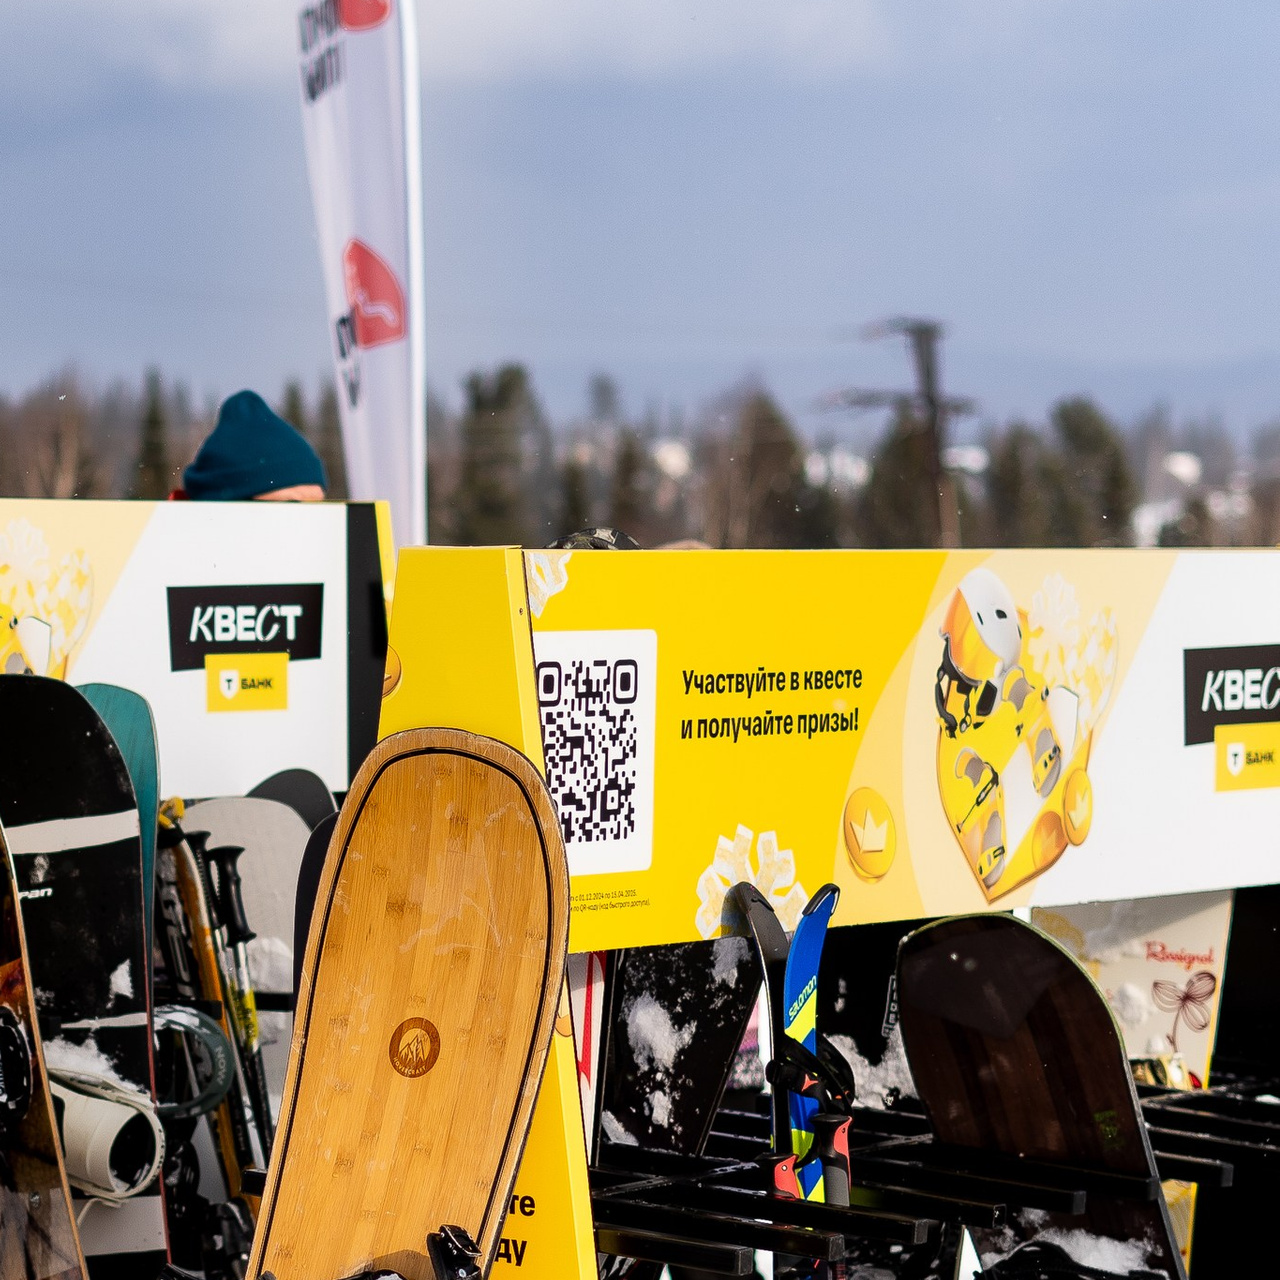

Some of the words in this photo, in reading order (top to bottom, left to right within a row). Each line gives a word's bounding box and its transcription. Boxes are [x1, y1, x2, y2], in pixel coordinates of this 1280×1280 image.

[189, 604, 303, 643] КВЕСТ
[240, 677, 274, 690] БАНК
[682, 666, 786, 699] Участвуйте
[790, 671, 800, 691] в
[803, 669, 863, 691] квесте
[681, 719, 693, 740] и
[697, 709, 794, 744] получайте
[797, 707, 859, 740] призы!
[494, 1237, 528, 1267] ду
